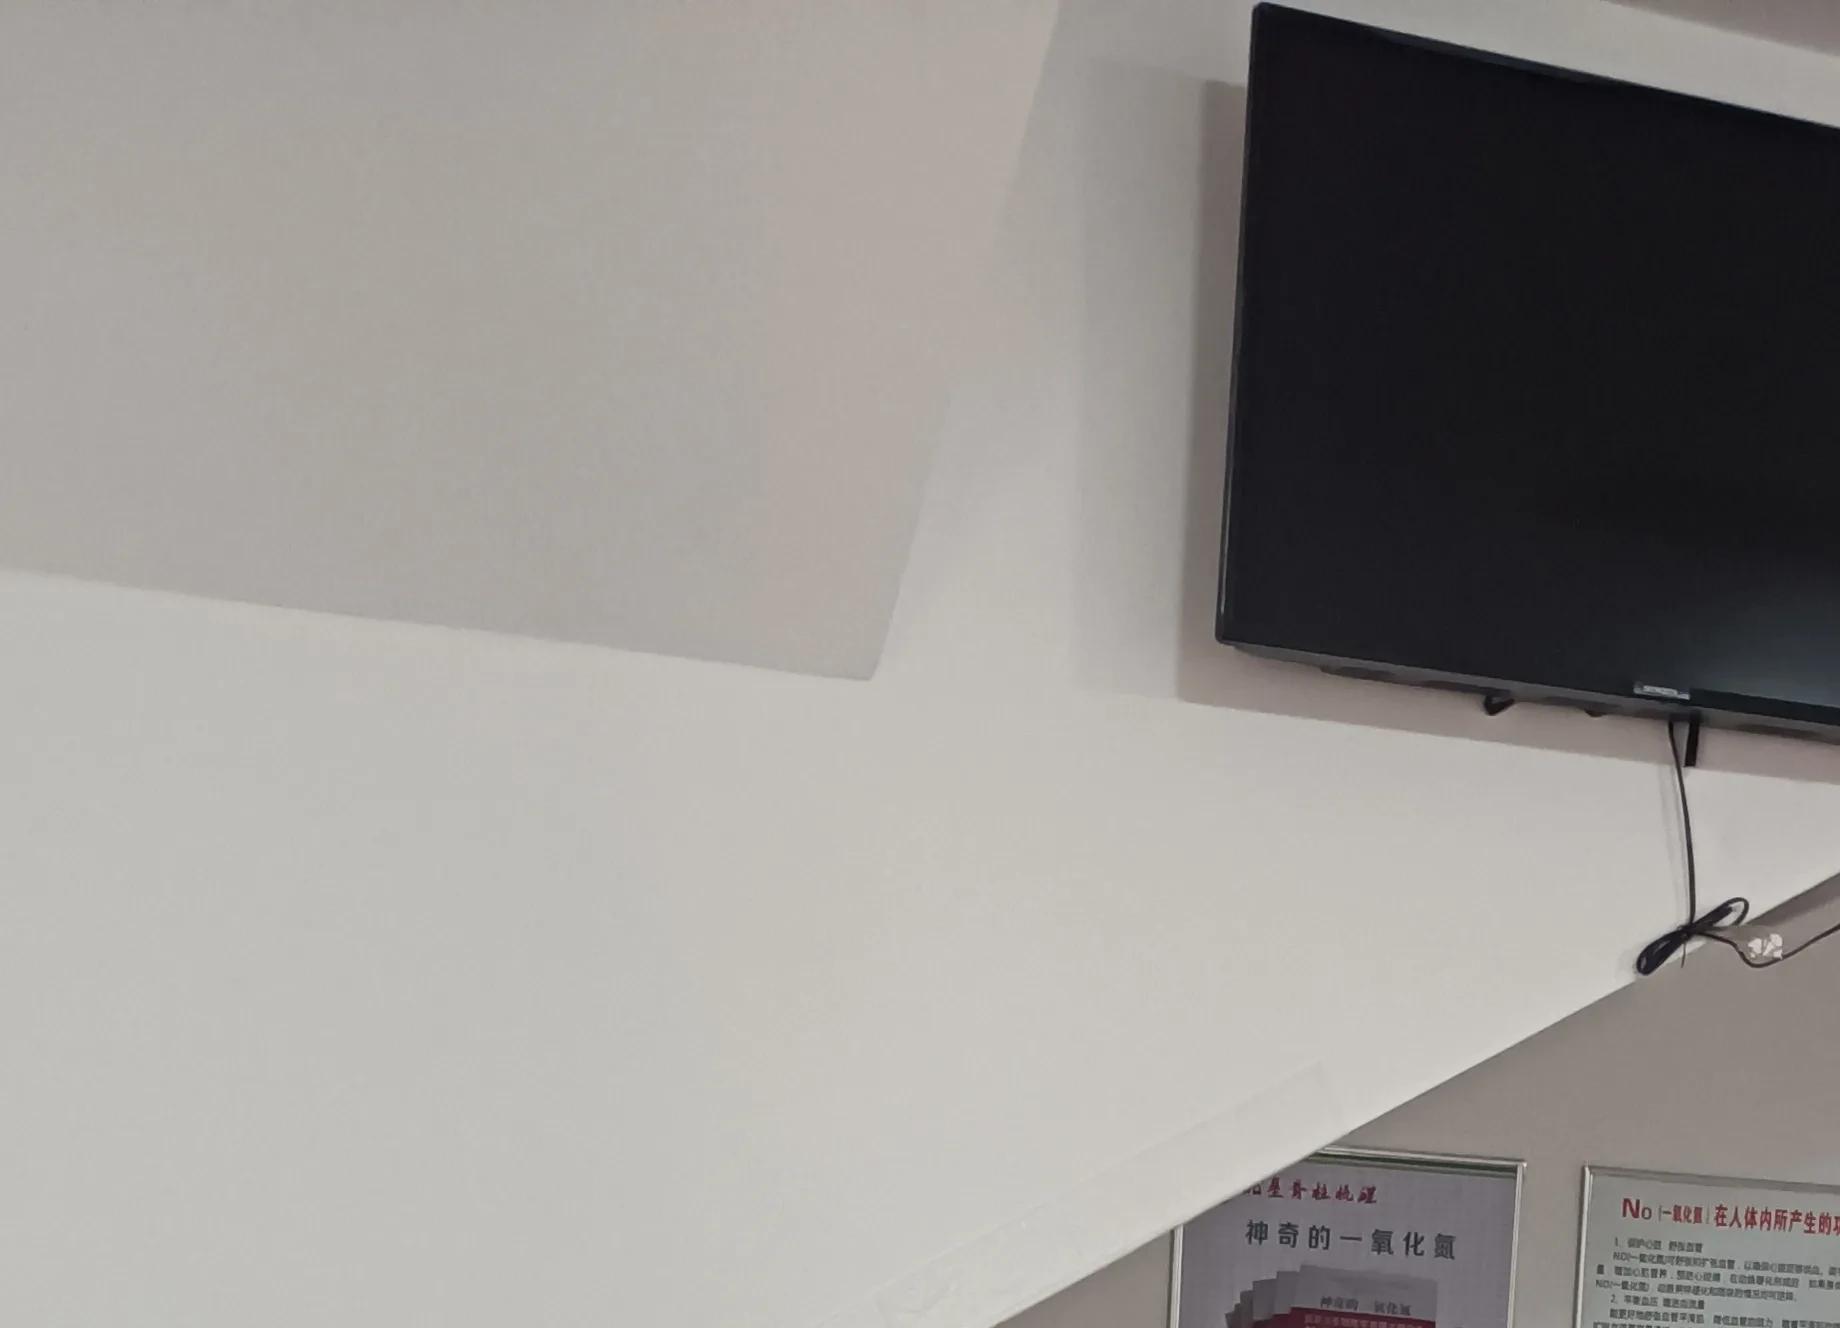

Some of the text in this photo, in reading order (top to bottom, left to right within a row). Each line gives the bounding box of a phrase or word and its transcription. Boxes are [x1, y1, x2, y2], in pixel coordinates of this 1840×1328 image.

[1245, 1219, 1457, 1260] 神奇的一氧化氮
